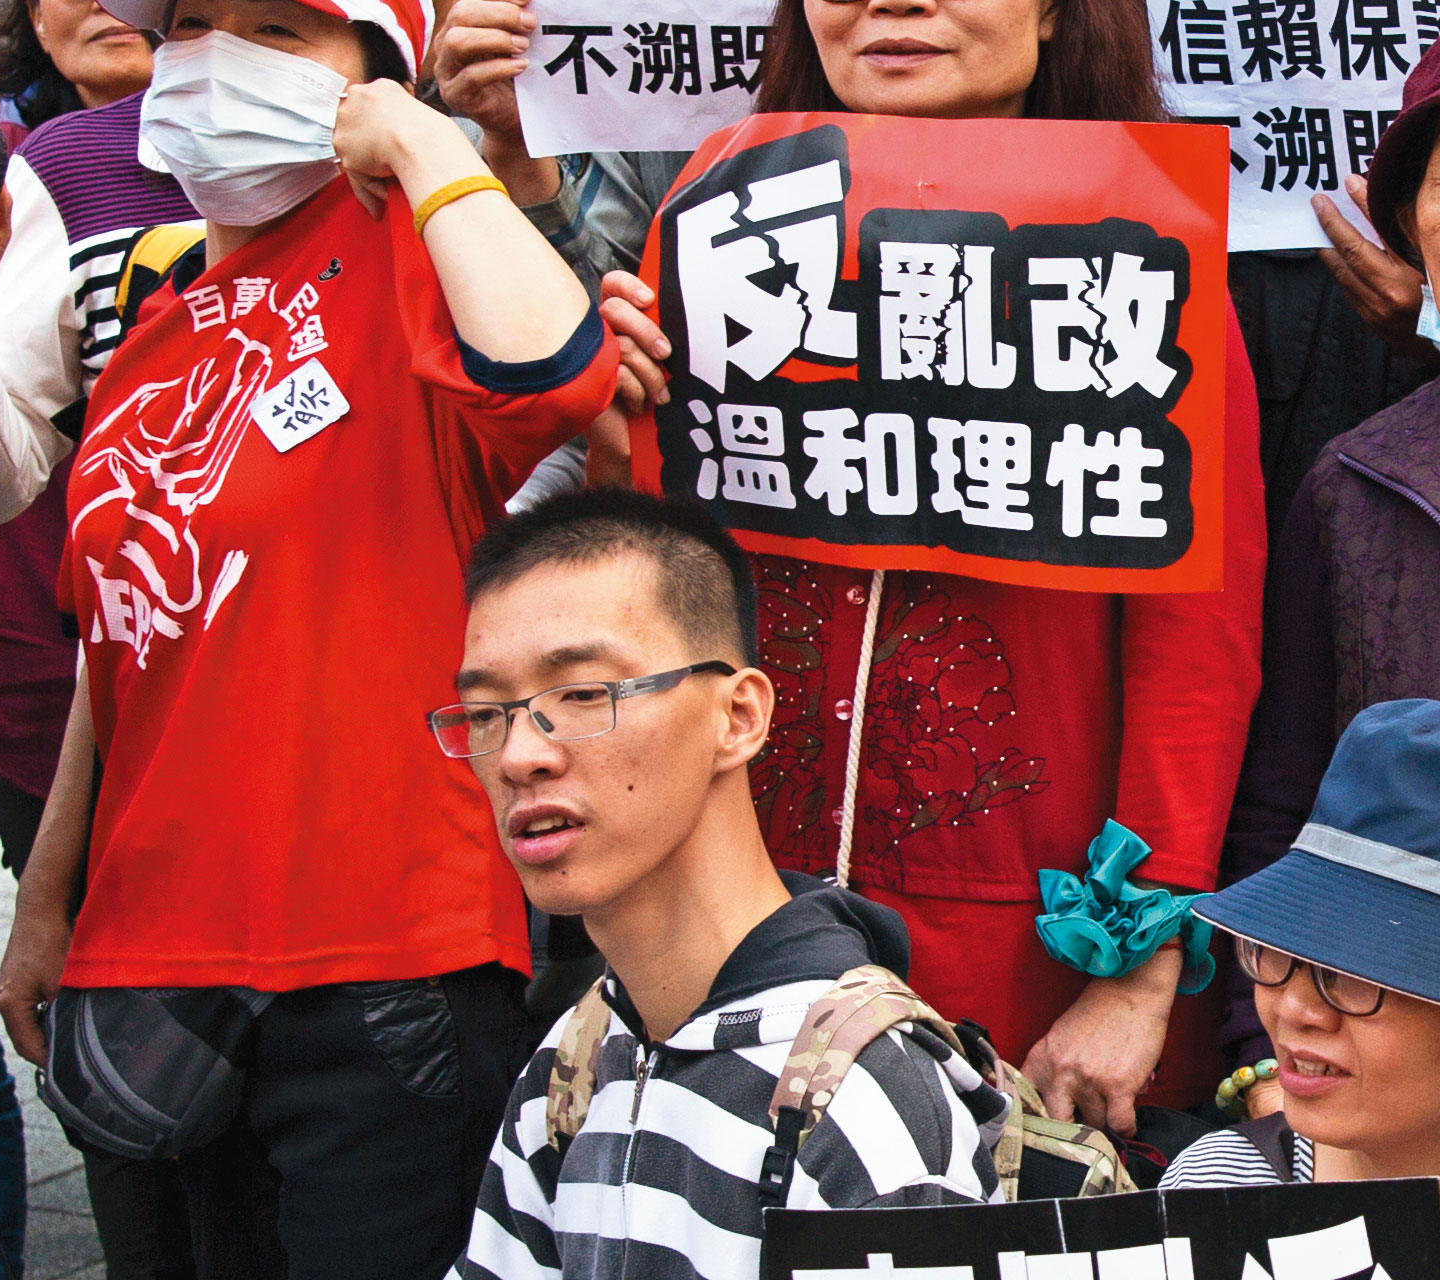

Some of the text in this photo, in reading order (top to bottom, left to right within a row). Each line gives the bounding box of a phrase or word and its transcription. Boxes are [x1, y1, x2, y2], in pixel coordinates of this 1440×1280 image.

[676, 158, 1178, 398] 反亂改
[686, 399, 1170, 540] 溫和理性
